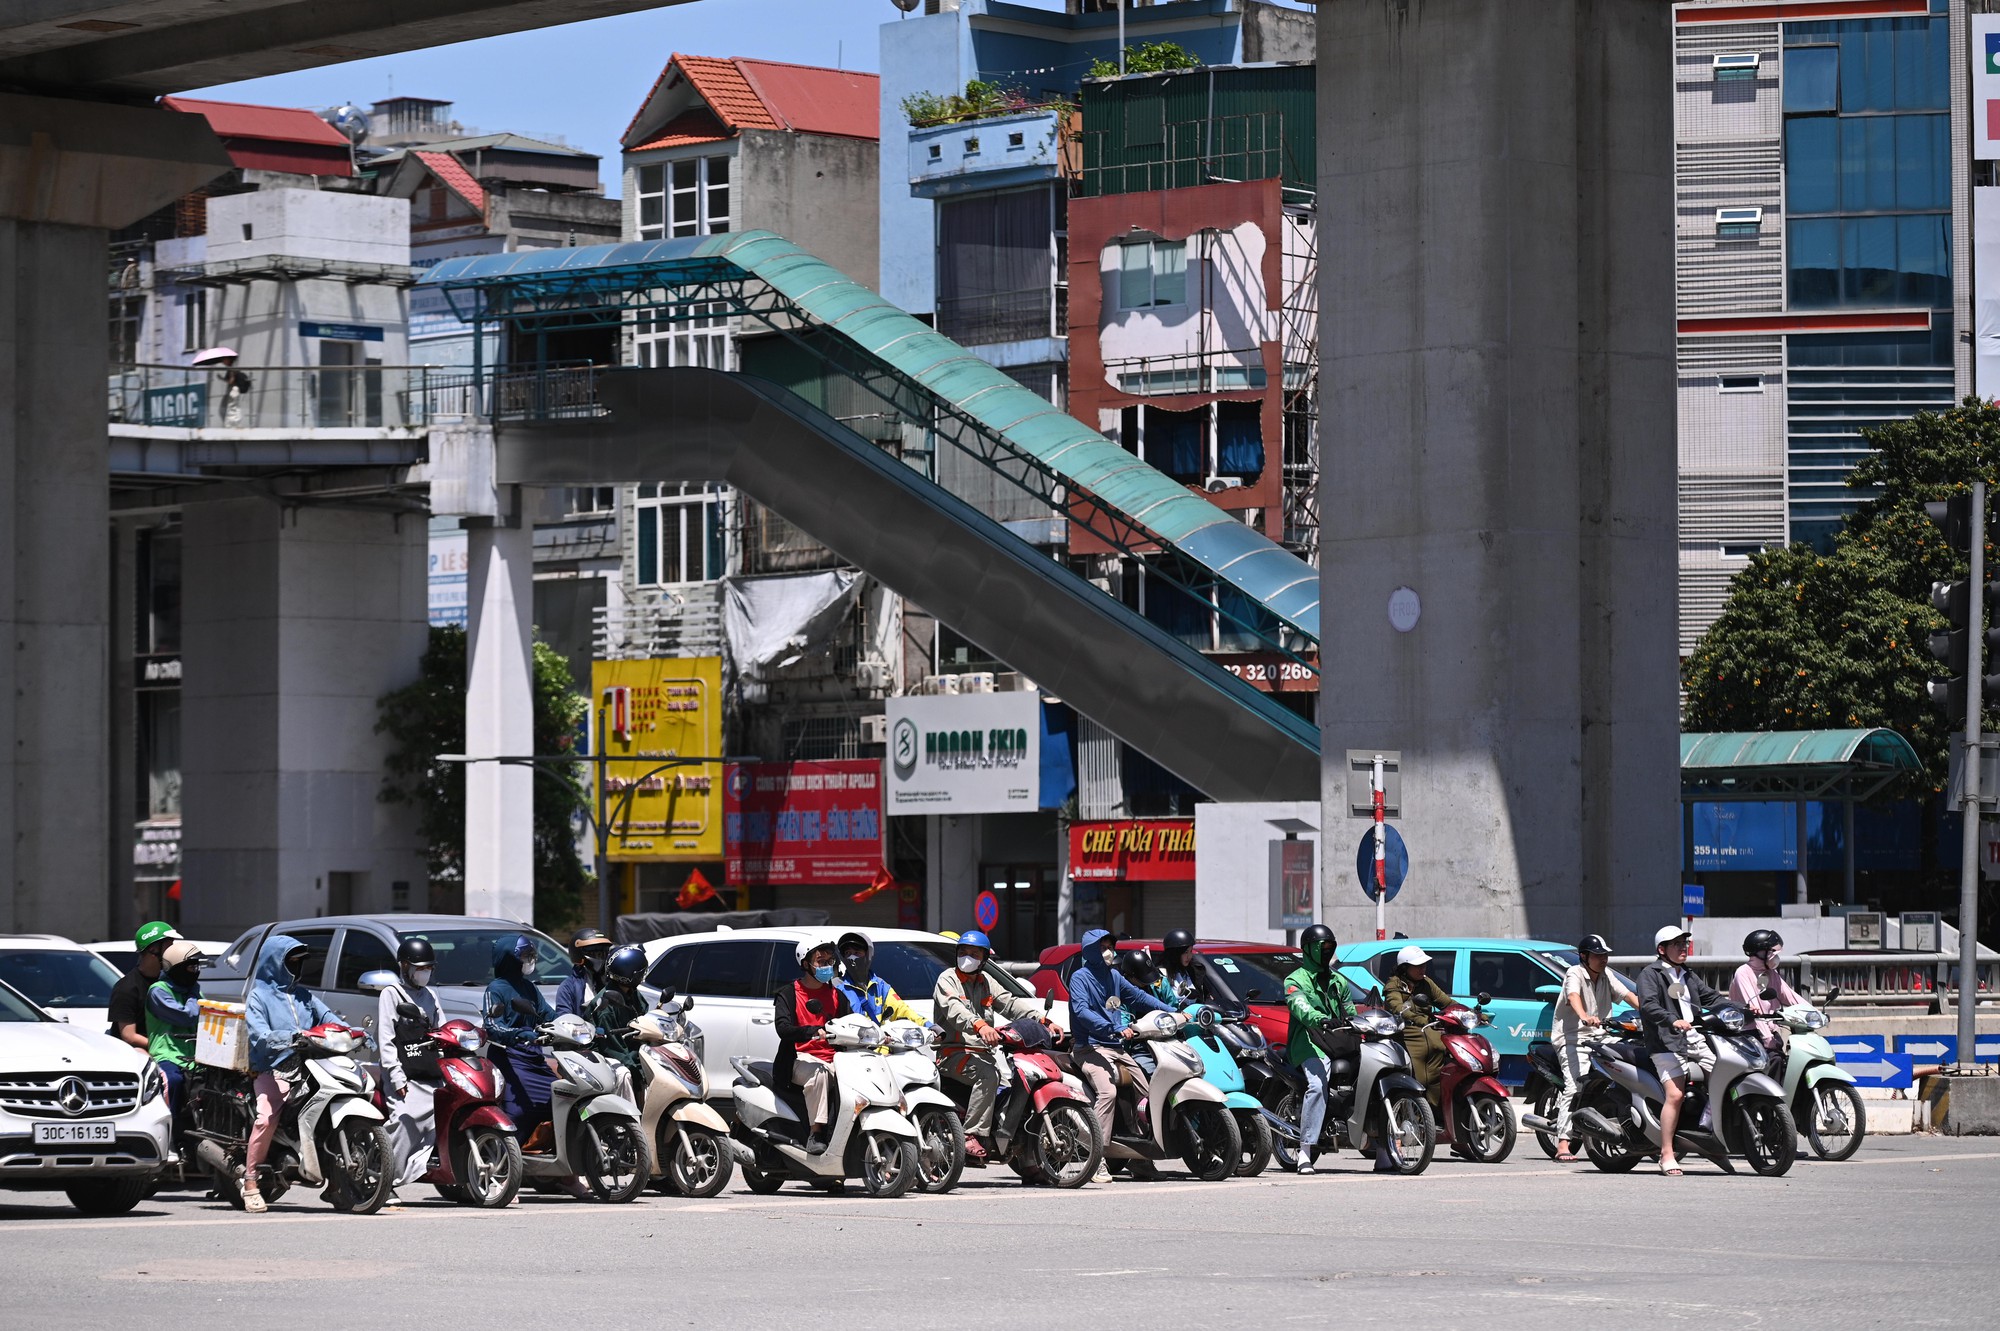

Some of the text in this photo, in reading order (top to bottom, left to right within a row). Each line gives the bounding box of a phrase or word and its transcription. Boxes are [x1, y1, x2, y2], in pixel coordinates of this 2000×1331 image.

[1393, 602, 1416, 616] FR02
[1246, 664, 1277, 680] 320
[1281, 663, 1312, 680] 266
[849, 773, 876, 789] APOLLO
[1082, 824, 1116, 853] CHÈ
[1158, 822, 1196, 852] THÁ
[1694, 845, 1711, 856] 355
[141, 926, 159, 940] Grab
[1860, 924, 1870, 938] B
[1521, 1030, 1543, 1038] XANH
[42, 1126, 109, 1140] 30C-161.99
